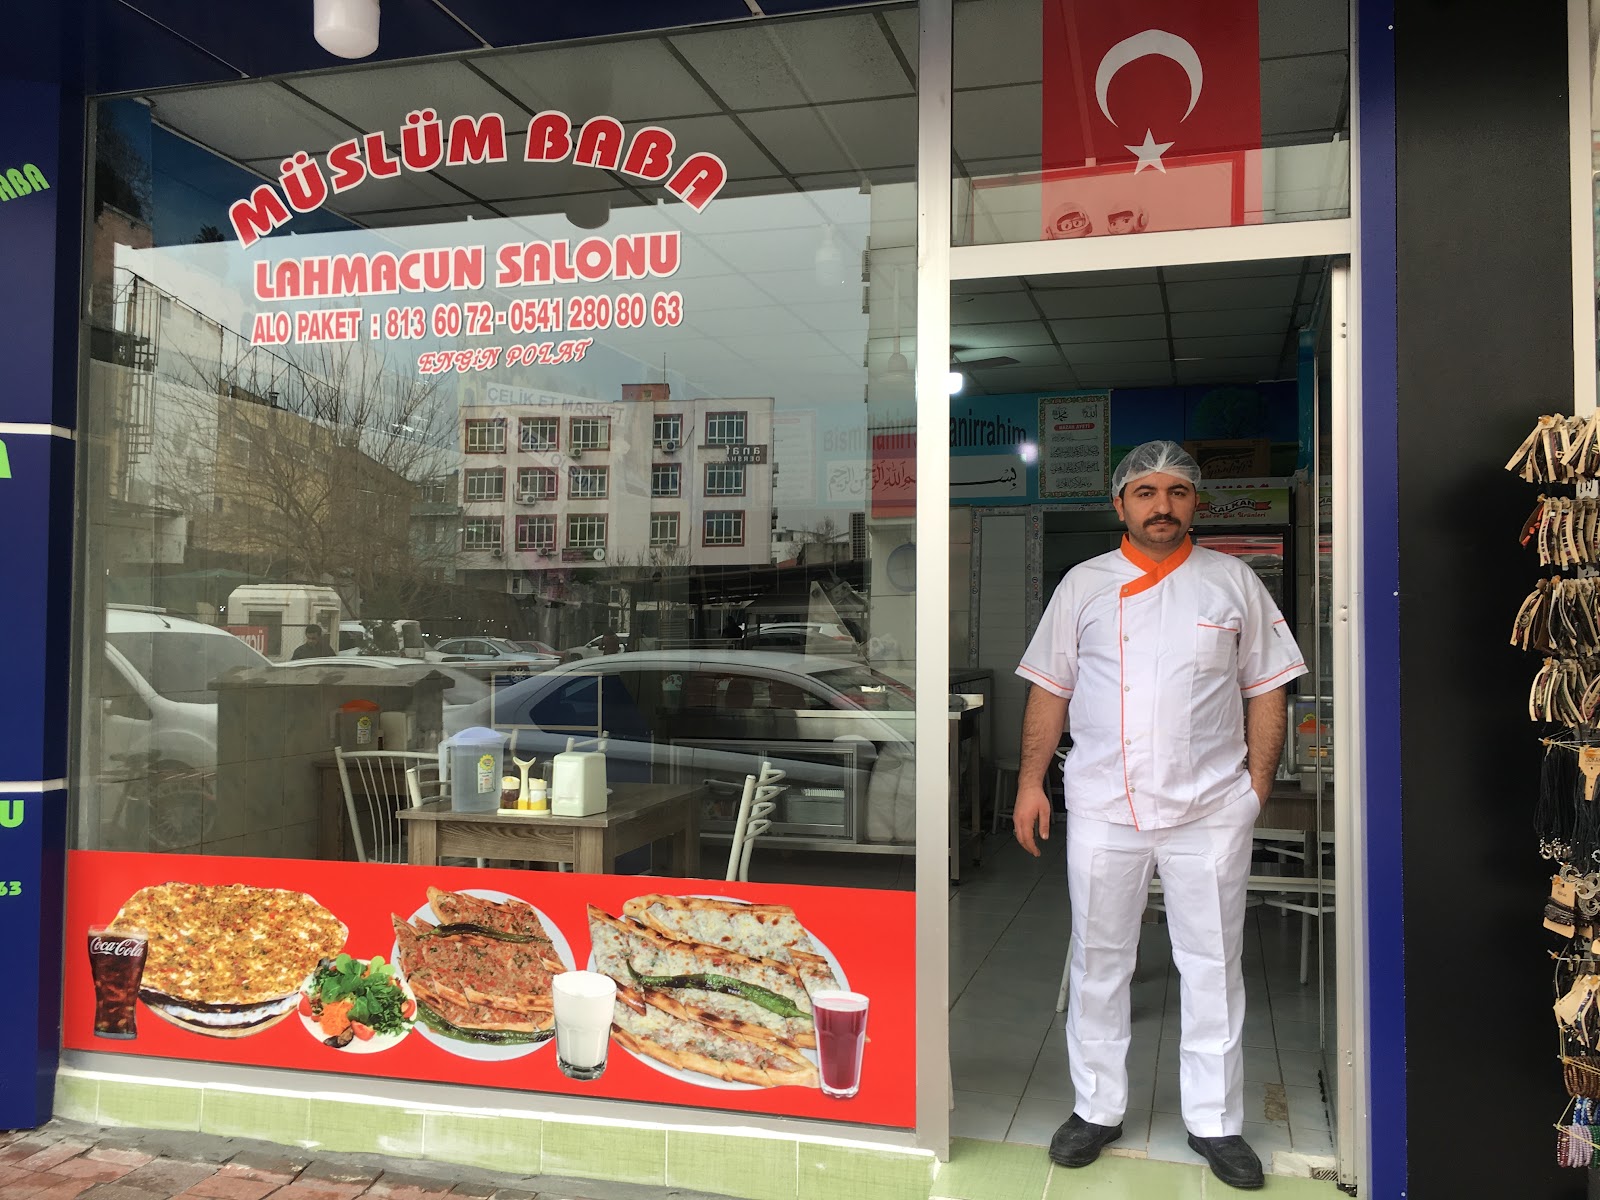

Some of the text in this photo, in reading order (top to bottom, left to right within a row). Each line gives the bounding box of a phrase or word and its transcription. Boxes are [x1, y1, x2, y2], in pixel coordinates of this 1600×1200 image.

[229, 108, 727, 249] MÜSLÜM BABA
[254, 231, 680, 301] LAHMACUN SALONU
[250, 310, 292, 346] ALO
[295, 308, 362, 344] PAKET
[385, 306, 426, 339] 813
[432, 303, 462, 337] 60
[464, 301, 494, 335] 72
[508, 298, 563, 334] 0541
[567, 295, 613, 331] 280
[615, 293, 647, 329] 80
[651, 291, 684, 327] 63
[506, 338, 594, 367] POLAT
[488, 386, 624, 423] ÇELİK ET MARKET
[1211, 500, 1255, 513] KALKAN
[90, 937, 144, 957] Coca-Cola
